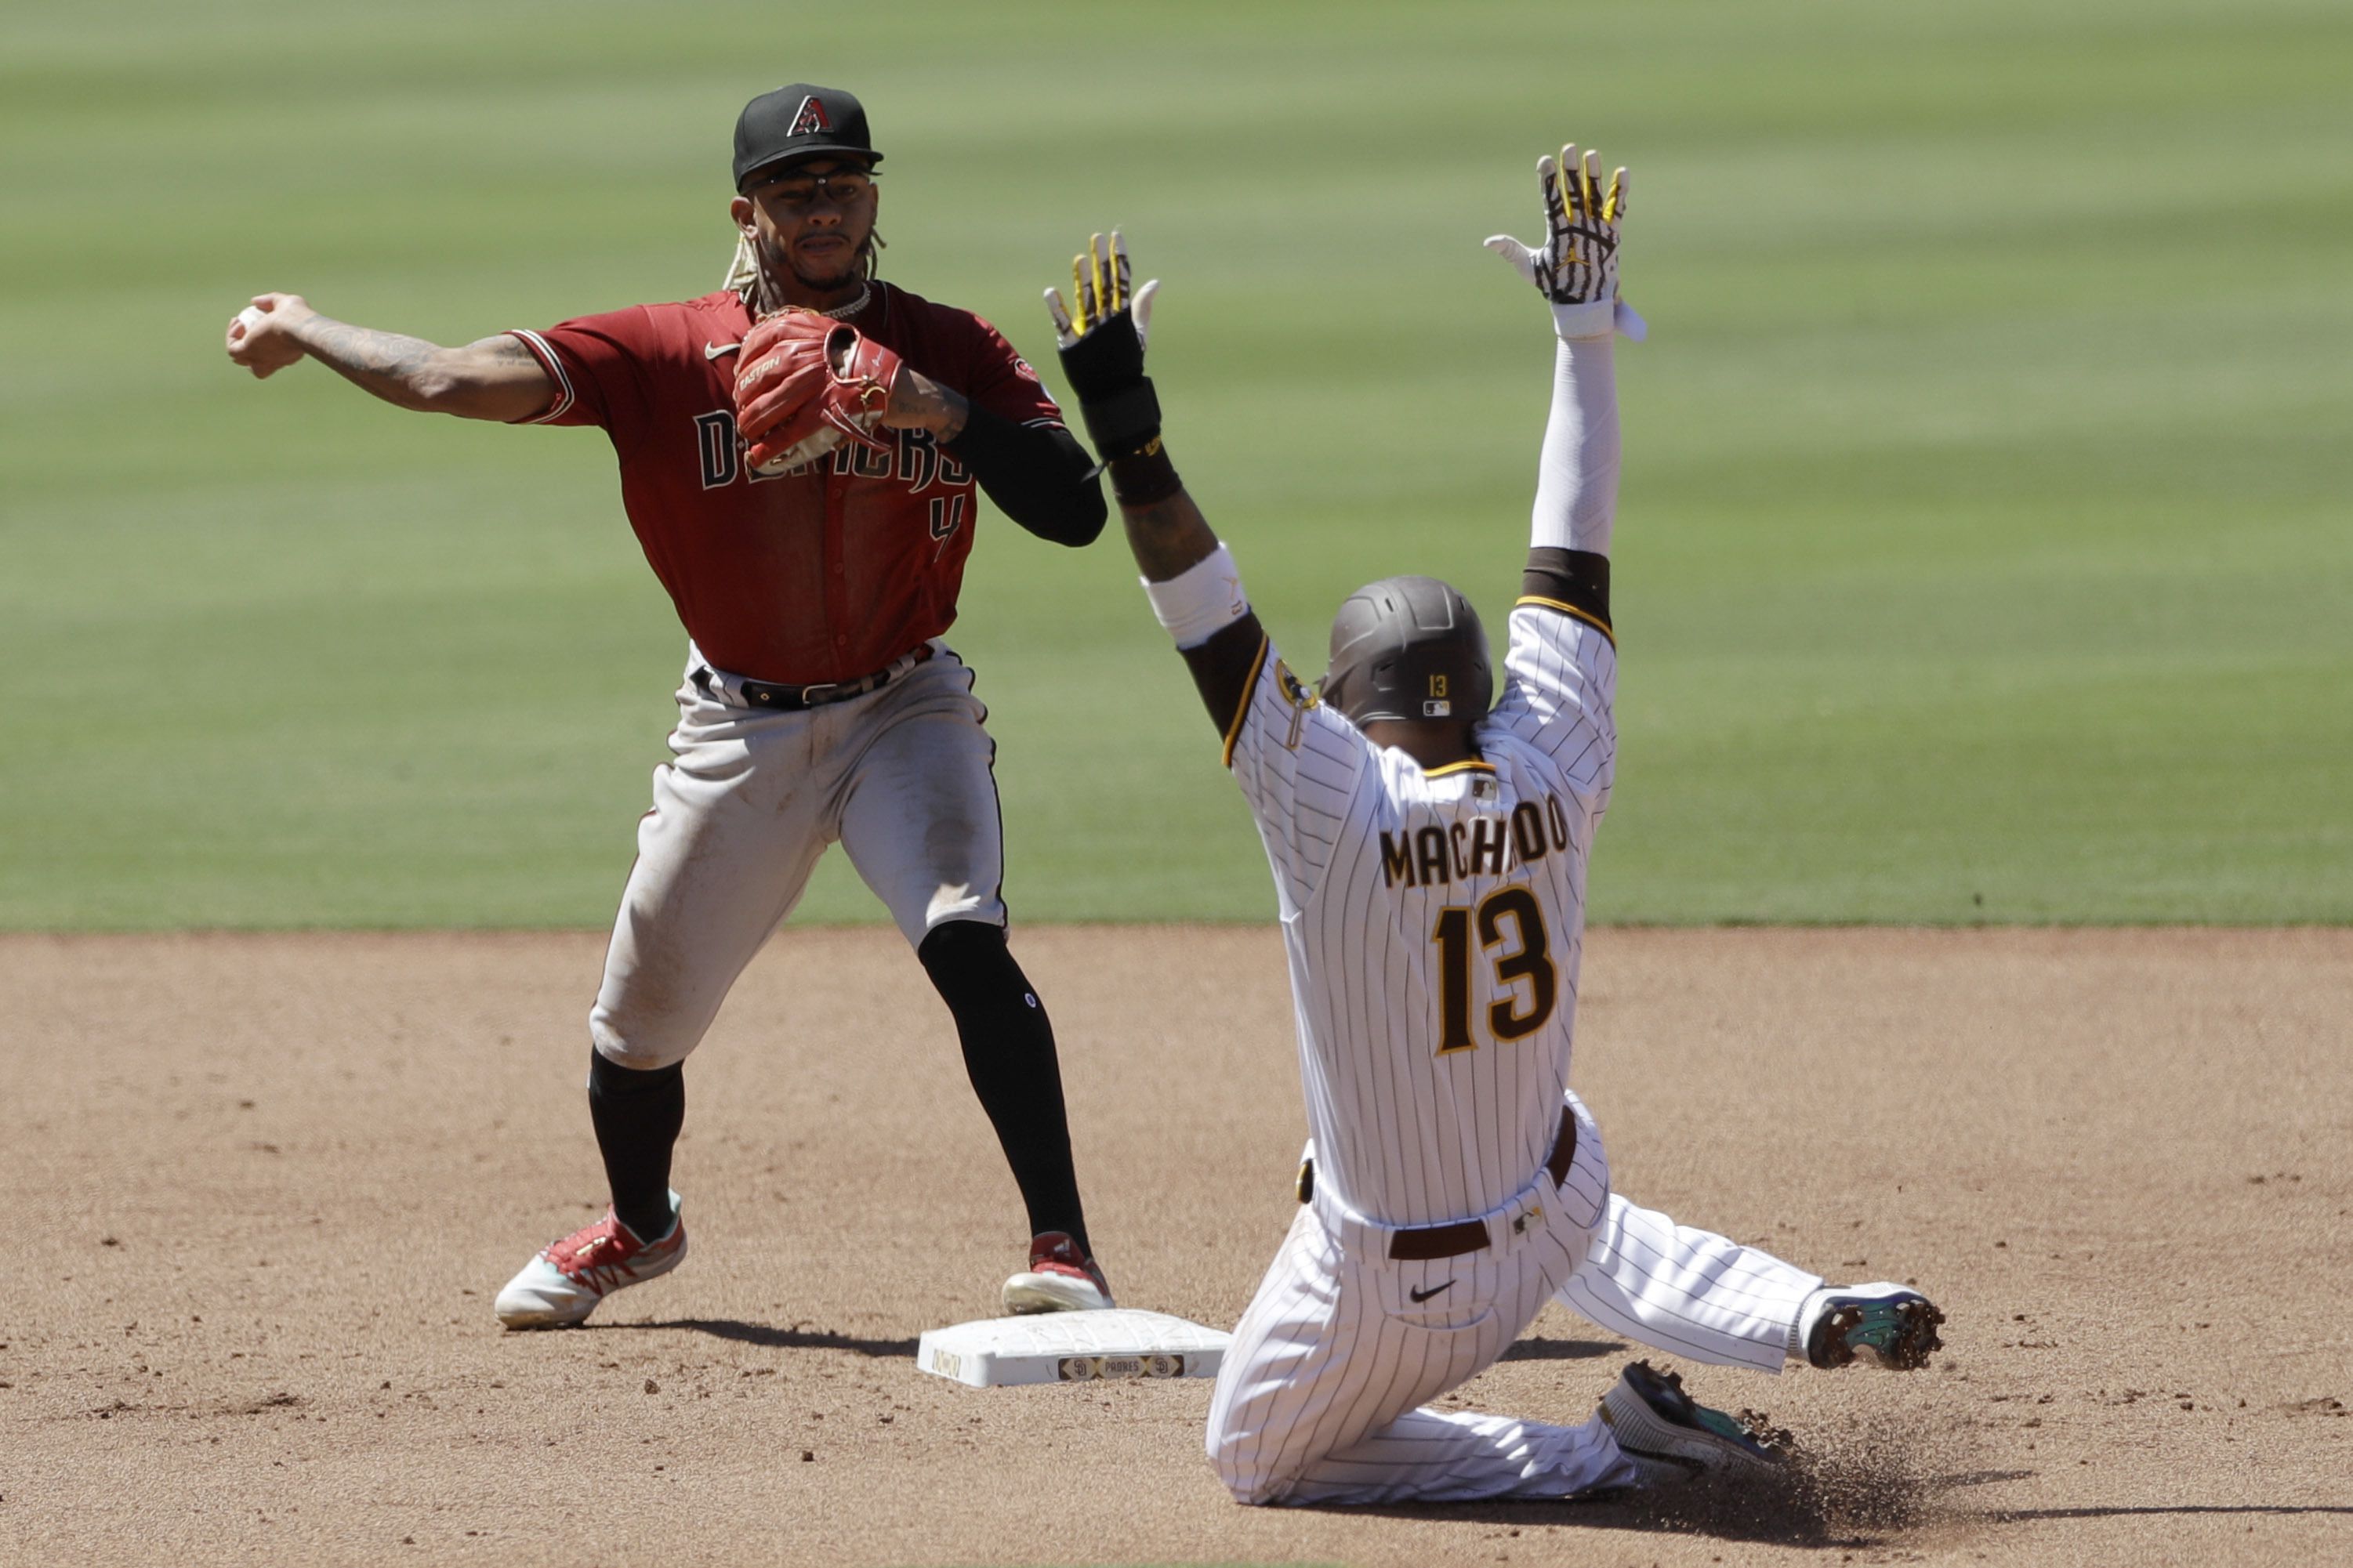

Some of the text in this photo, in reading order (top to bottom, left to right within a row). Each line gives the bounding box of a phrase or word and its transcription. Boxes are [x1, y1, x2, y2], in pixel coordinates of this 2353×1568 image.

[739, 356, 781, 392] EASTON
[929, 494, 966, 563] 4
[1428, 673, 1448, 698] 13
[1380, 794, 1568, 889] MACHDO
[1430, 883, 1558, 1058] 13
[1105, 1360, 1139, 1373] PADRES
